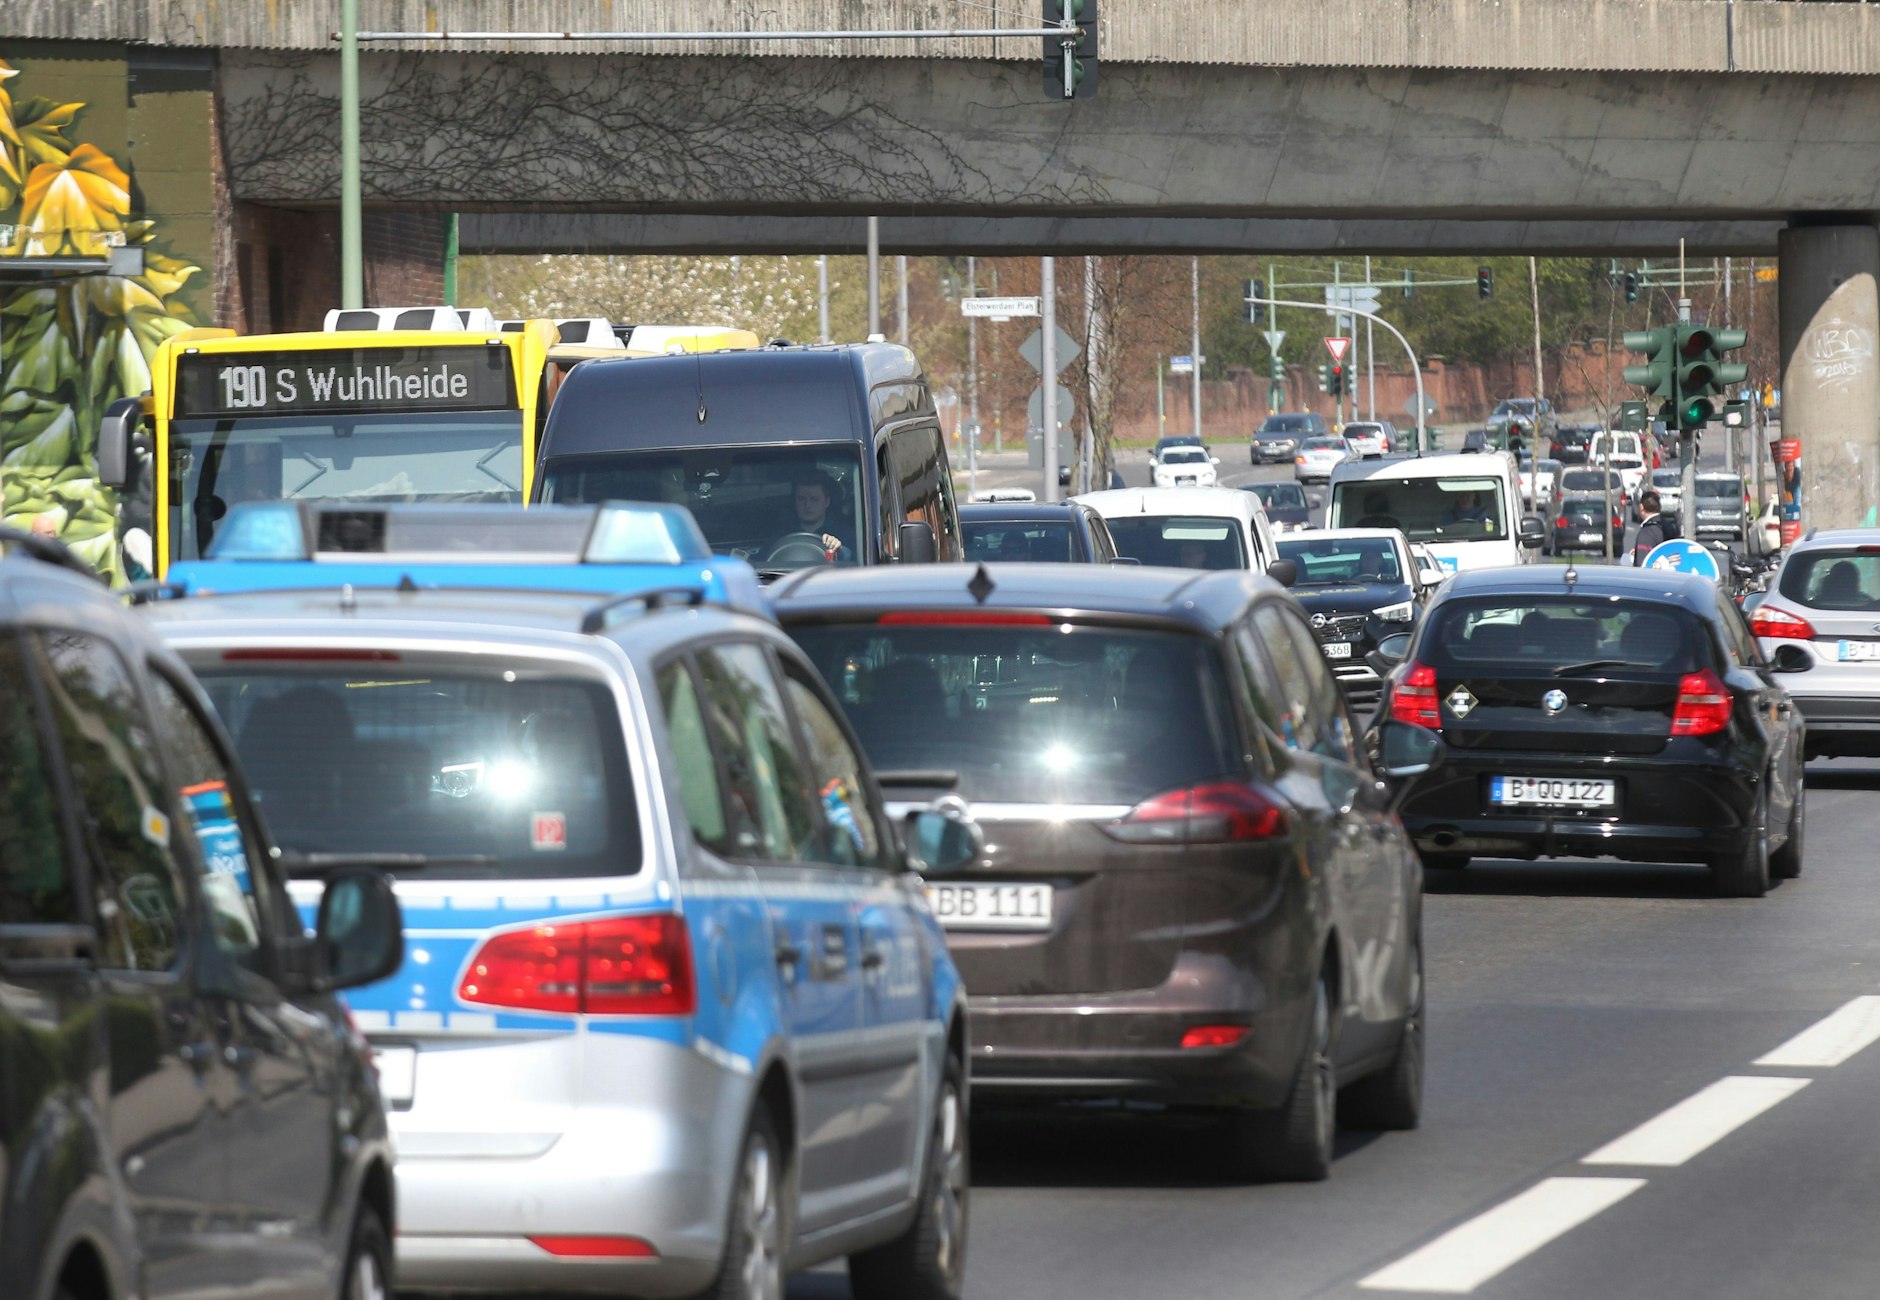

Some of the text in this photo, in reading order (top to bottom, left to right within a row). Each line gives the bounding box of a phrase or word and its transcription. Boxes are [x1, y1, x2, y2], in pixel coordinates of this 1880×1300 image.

[219, 364, 468, 408] 190 S Wuhlheide
[1849, 643, 1858, 657] B
[1512, 779, 1605, 801] B QQ 122
[937, 886, 1046, 918] BB 111
